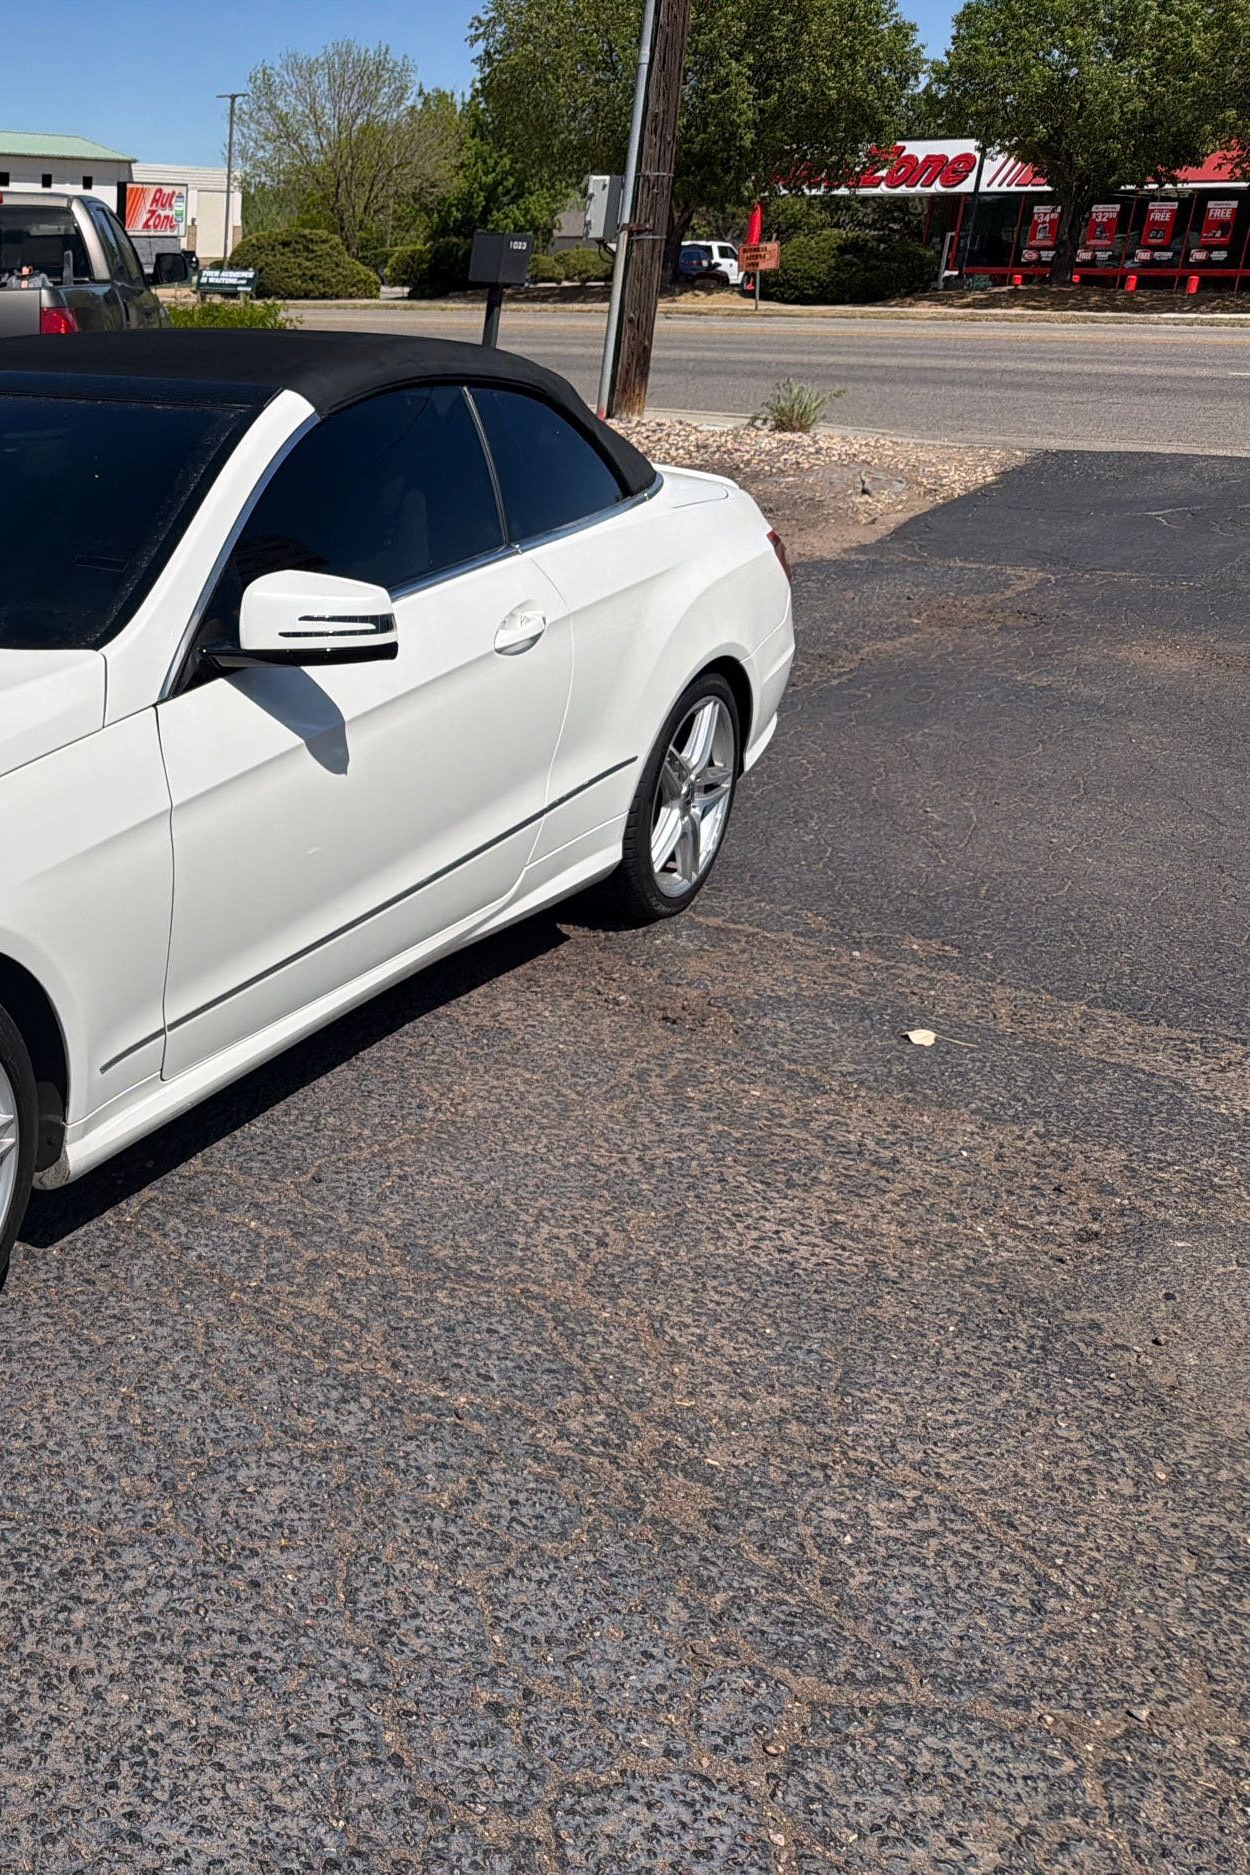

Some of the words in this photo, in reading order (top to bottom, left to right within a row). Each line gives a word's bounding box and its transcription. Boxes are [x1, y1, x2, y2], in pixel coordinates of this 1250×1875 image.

[150, 187, 175, 208] Aut
[1150, 212, 1172, 221] FREE
[1209, 208, 1232, 218] FREE
